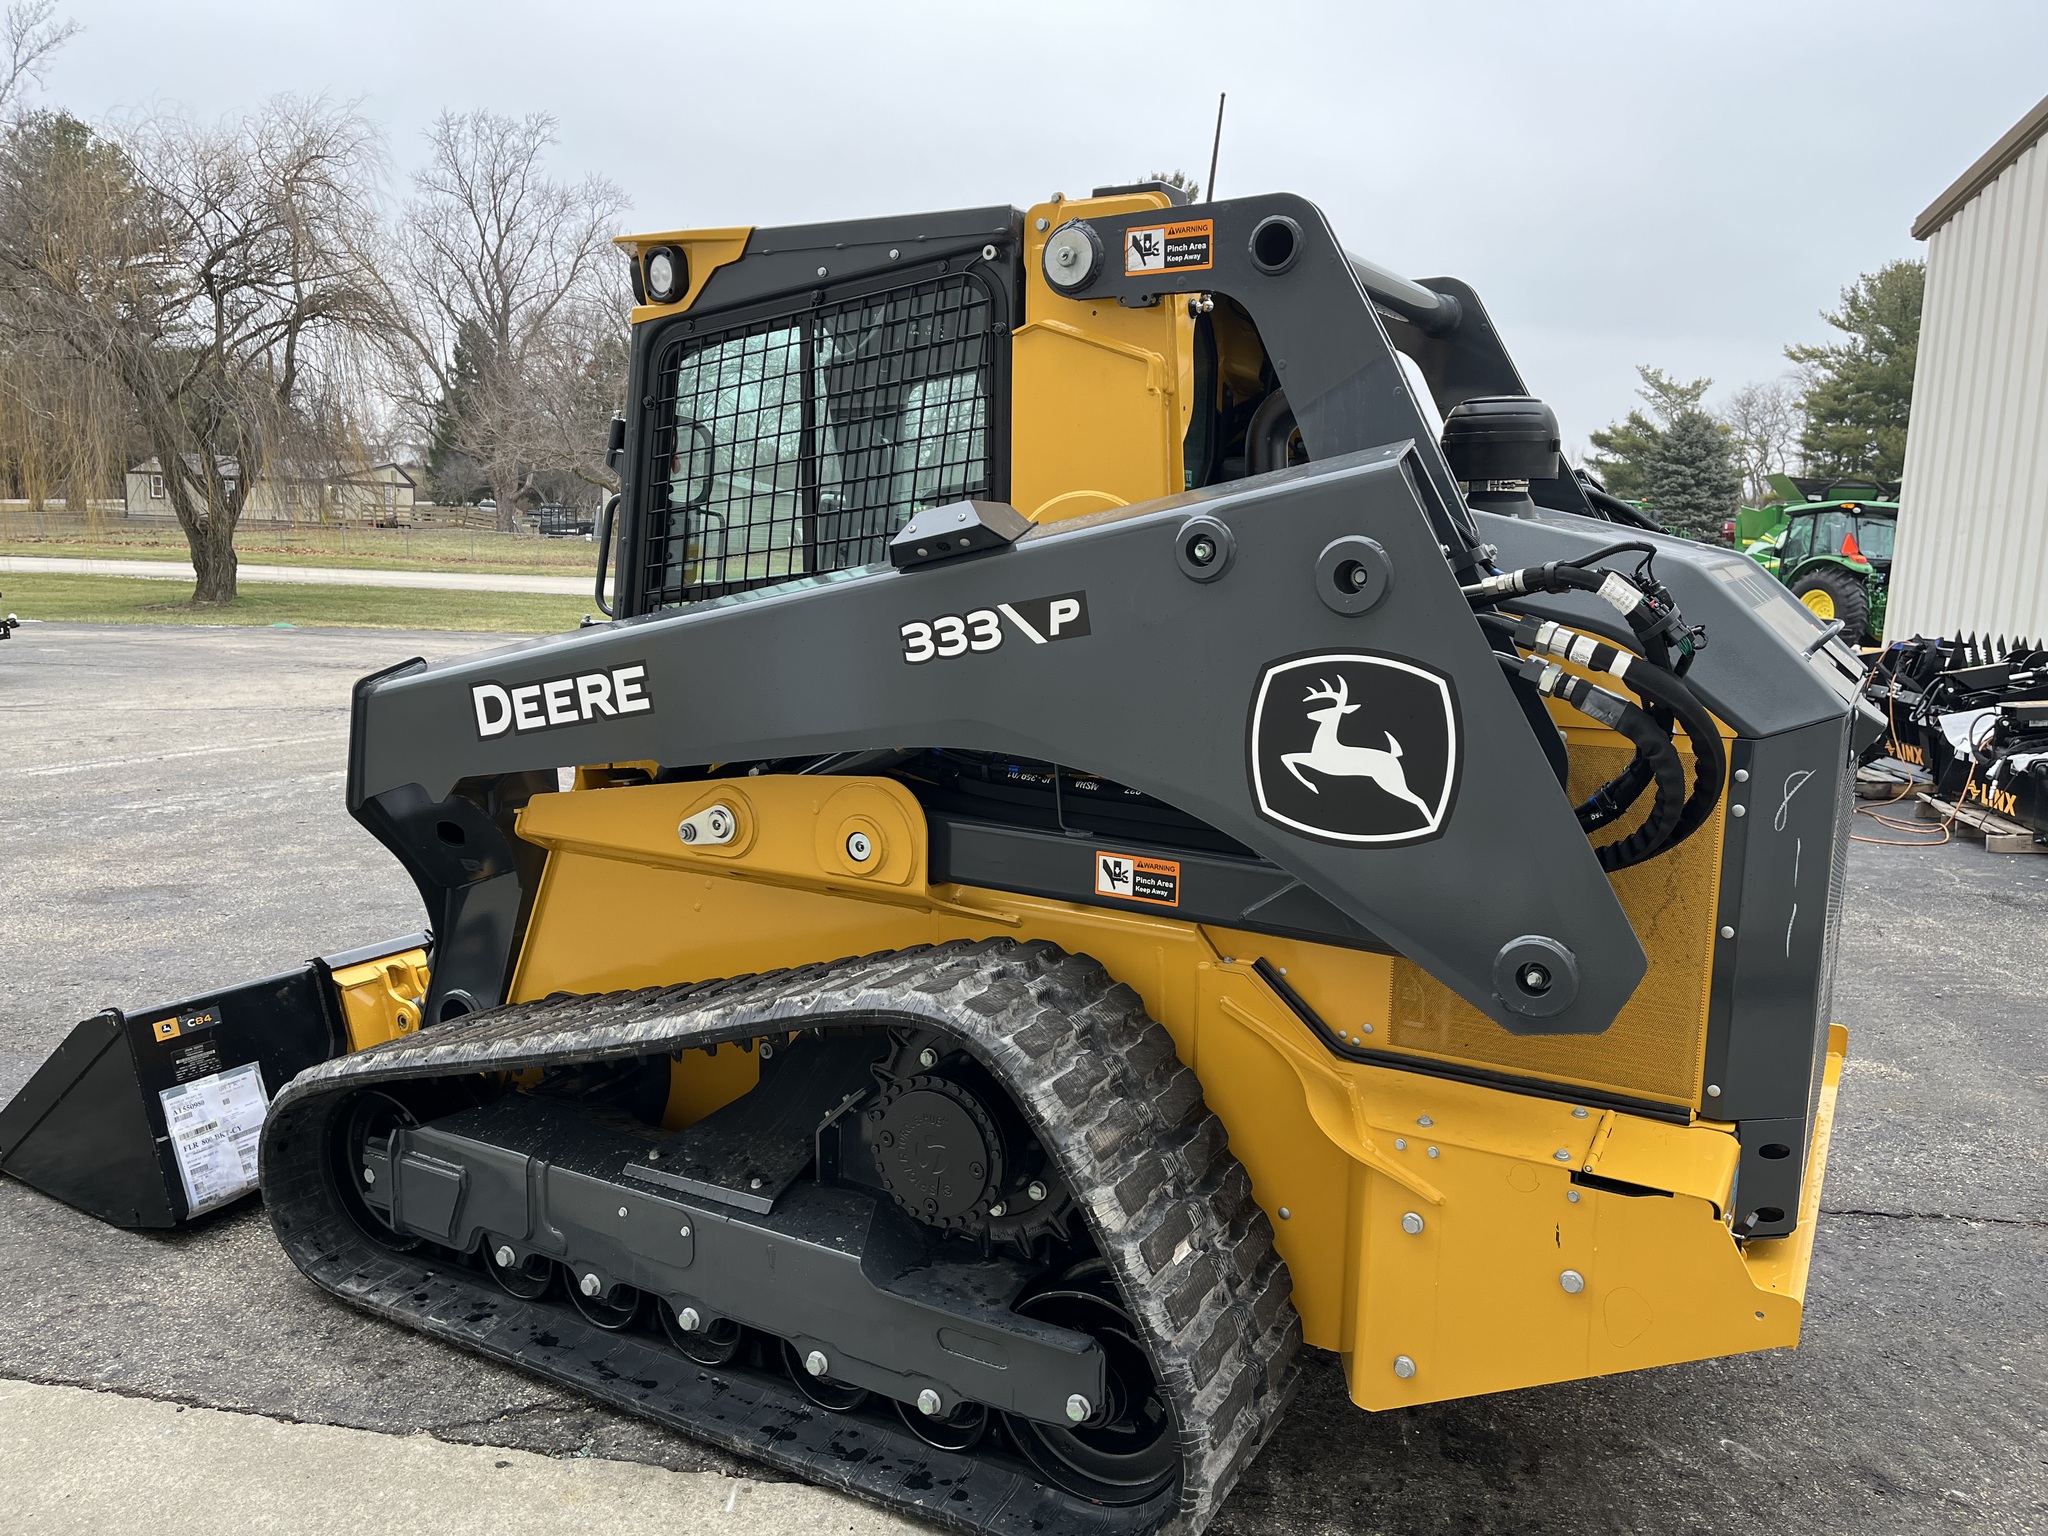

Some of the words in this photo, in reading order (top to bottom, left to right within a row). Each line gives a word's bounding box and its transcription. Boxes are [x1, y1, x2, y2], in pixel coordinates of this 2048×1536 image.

[1175, 224, 1208, 235] WARNING
[1167, 242, 1188, 253] Pinch
[1189, 242, 1207, 251] Area
[1167, 254, 1183, 263] Keep
[1184, 253, 1201, 262] Away
[901, 610, 1002, 662] 333
[472, 665, 650, 737] DEERE
[1075, 781, 1099, 791] MSHA
[1144, 863, 1176, 873] WARNING
[1135, 876, 1156, 886] Pinch
[1156, 879, 1174, 889] Area
[1135, 885, 1151, 895] Keep
[1151, 887, 1168, 897] Away
[187, 1014, 212, 1027] C84
[183, 1142, 199, 1153] FLR
